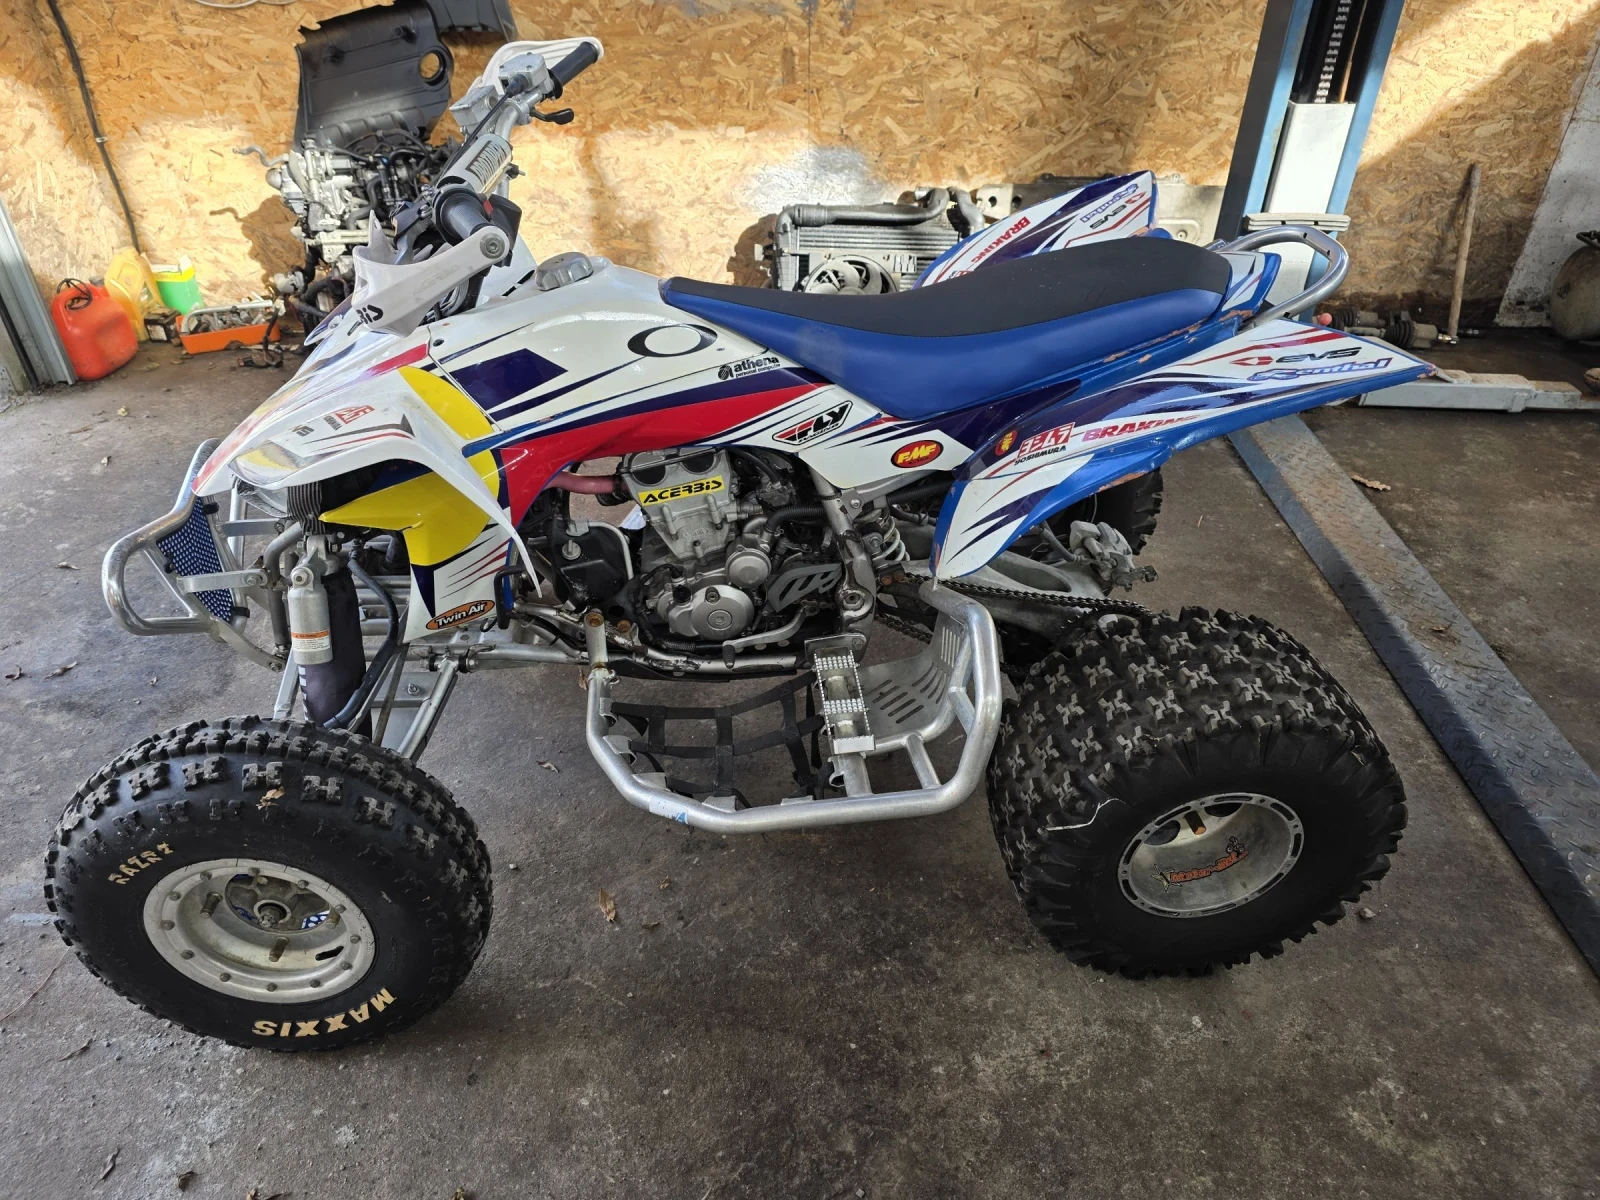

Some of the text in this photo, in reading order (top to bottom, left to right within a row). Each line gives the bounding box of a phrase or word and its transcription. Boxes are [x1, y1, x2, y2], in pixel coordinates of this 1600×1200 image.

[971, 216, 1031, 264] BRAKING
[733, 356, 780, 373] athena
[1246, 357, 1393, 382] Renthal
[775, 403, 850, 442] FLY
[1082, 414, 1203, 443] BRAKING
[896, 443, 938, 464] FMF
[1014, 445, 1067, 466] YOSHIMURA
[436, 602, 487, 627] Twin Air
[252, 987, 397, 1038] MAXXIS
